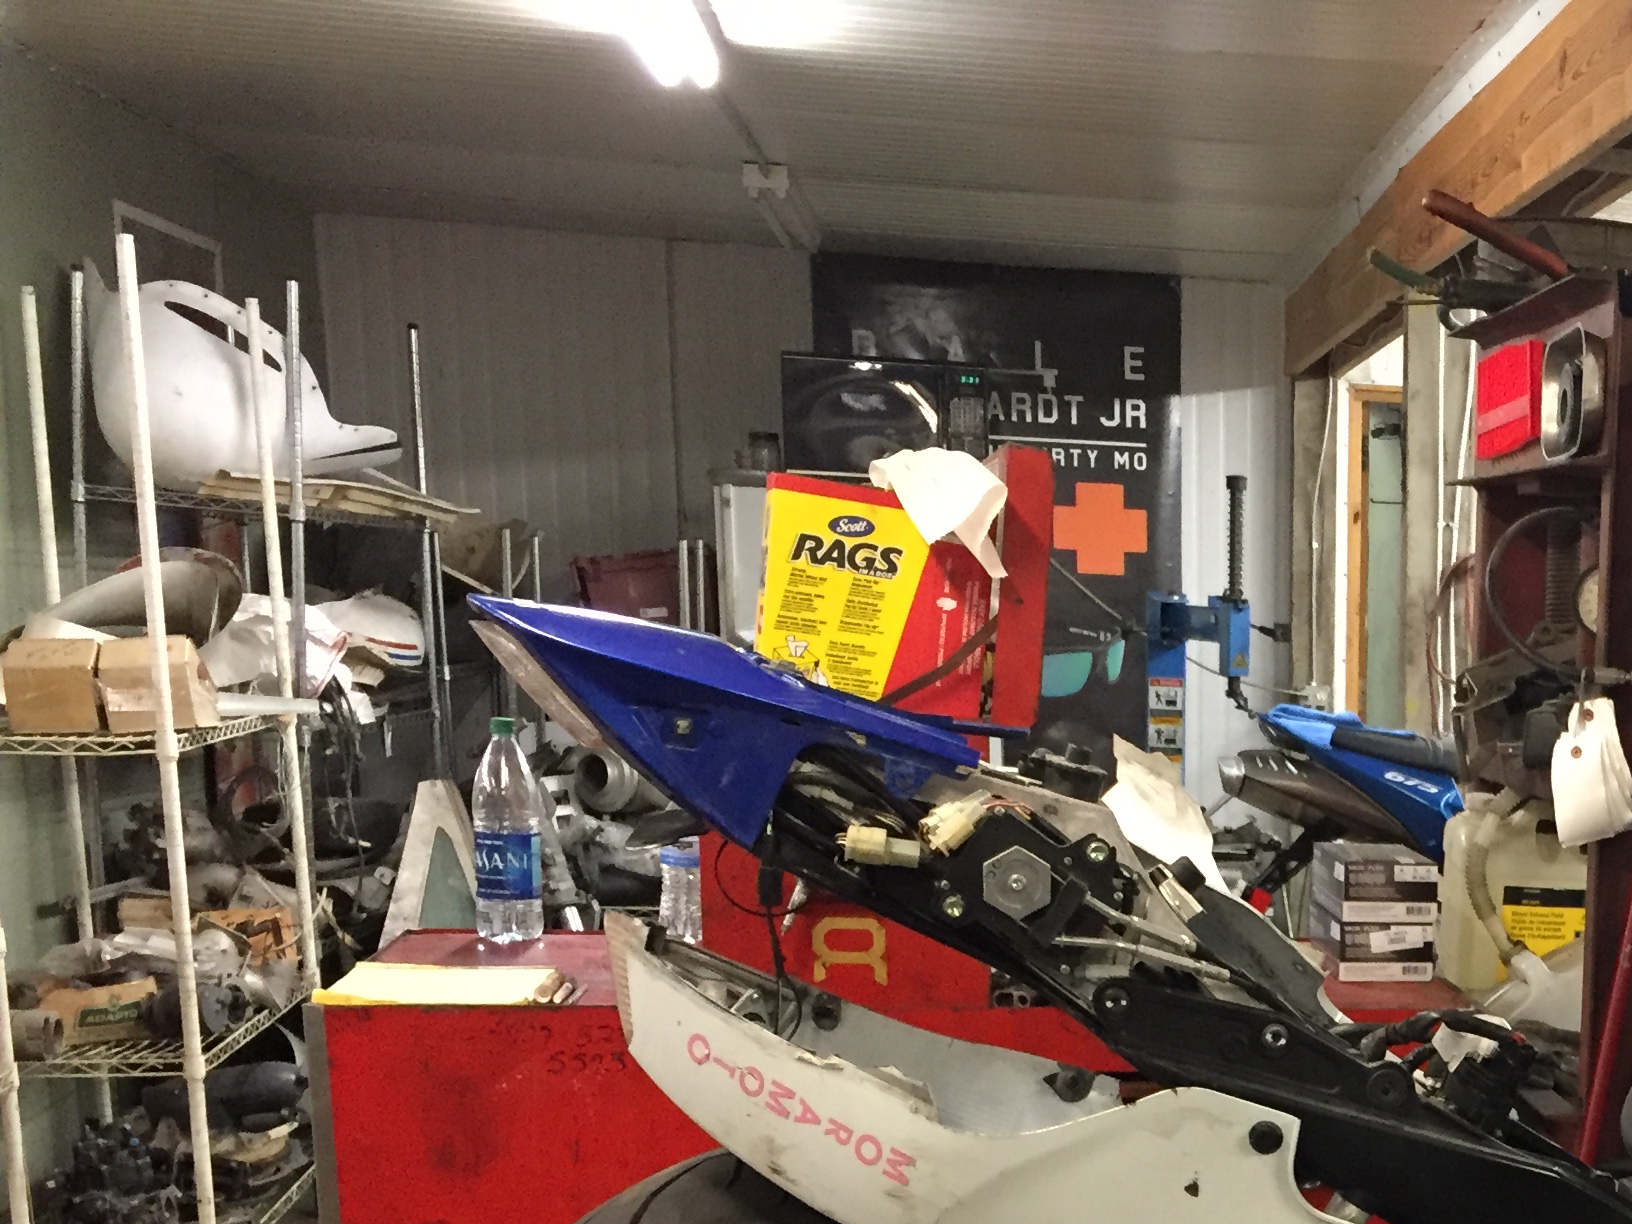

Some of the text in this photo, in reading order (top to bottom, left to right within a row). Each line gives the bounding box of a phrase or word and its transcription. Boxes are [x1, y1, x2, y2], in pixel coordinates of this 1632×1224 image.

[988, 391, 1147, 429] ARDT JR
[1051, 447, 1147, 471] RTY MO
[836, 518, 868, 533] Scott
[790, 532, 904, 577] RAGS
[476, 848, 528, 872] ASANI
